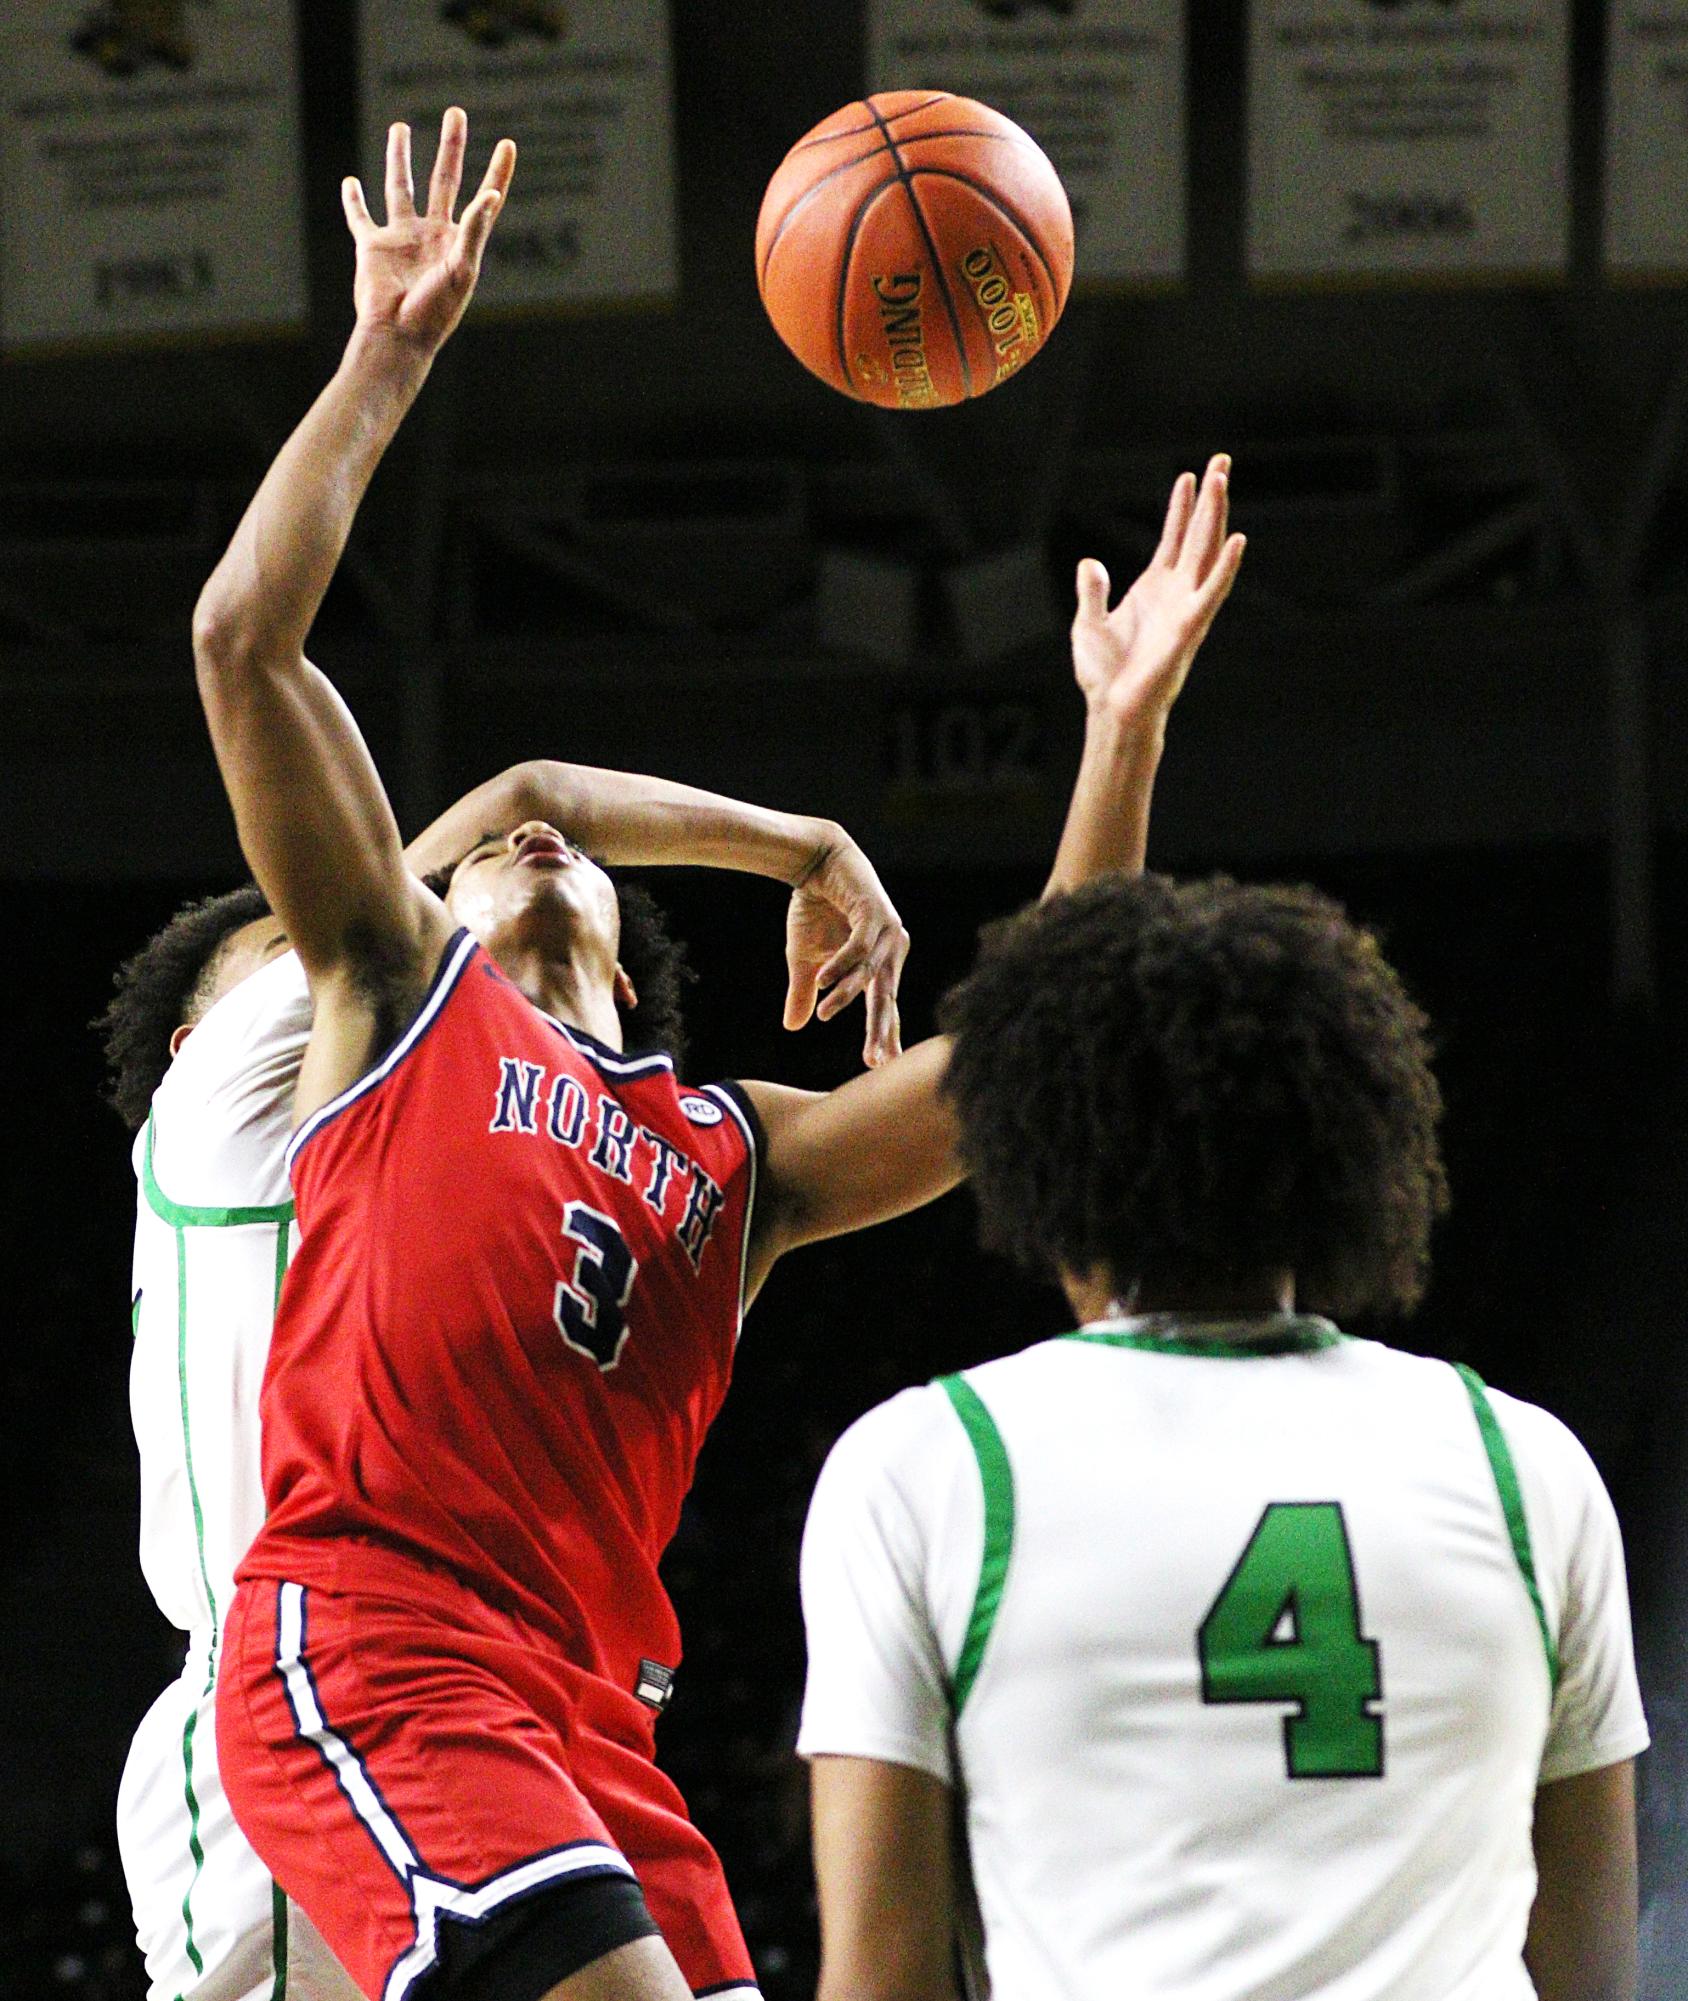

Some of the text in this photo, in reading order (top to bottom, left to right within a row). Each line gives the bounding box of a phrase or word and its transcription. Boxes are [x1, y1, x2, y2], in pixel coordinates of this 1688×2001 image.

[897, 705, 1041, 791] 102
[488, 1056, 725, 1277] NORTH
[553, 1200, 638, 1372] 3
[1196, 1502, 1385, 1779] 4
